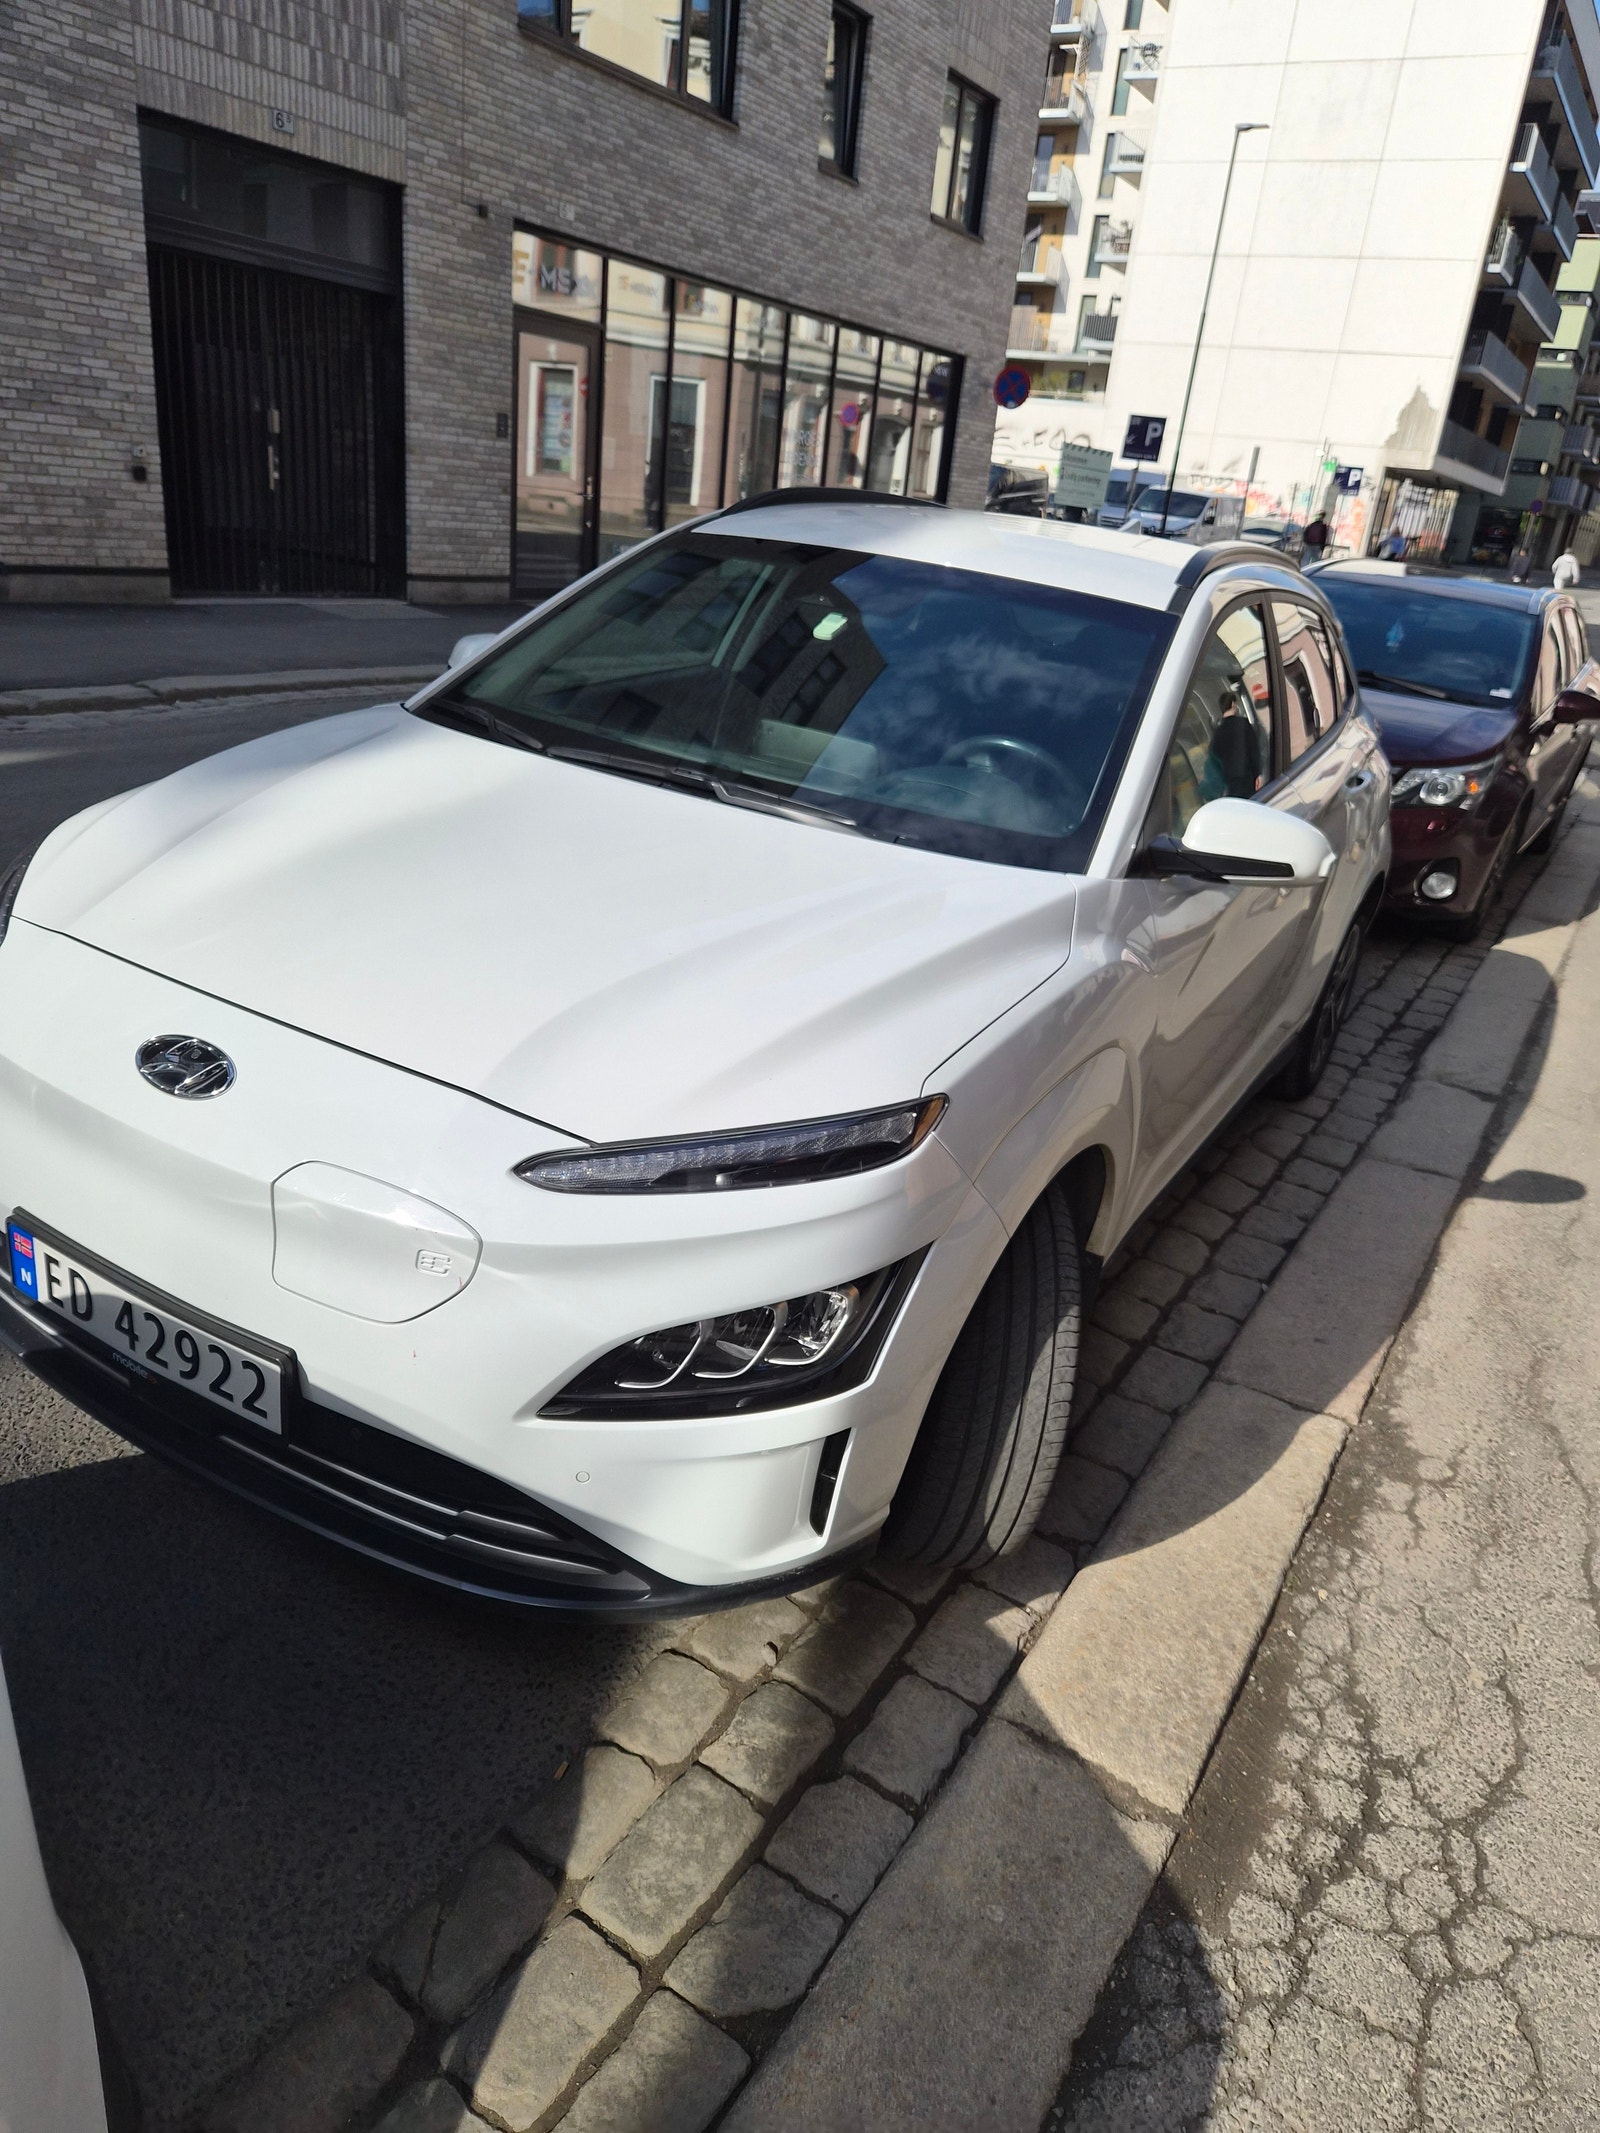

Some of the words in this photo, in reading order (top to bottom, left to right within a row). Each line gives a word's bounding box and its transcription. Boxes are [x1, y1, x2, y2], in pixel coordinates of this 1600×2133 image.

[1144, 421, 1163, 447] P
[1347, 468, 1362, 487] P
[20, 1267, 32, 1286] N
[44, 1251, 93, 1322] ED
[114, 1300, 268, 1419] 42922
